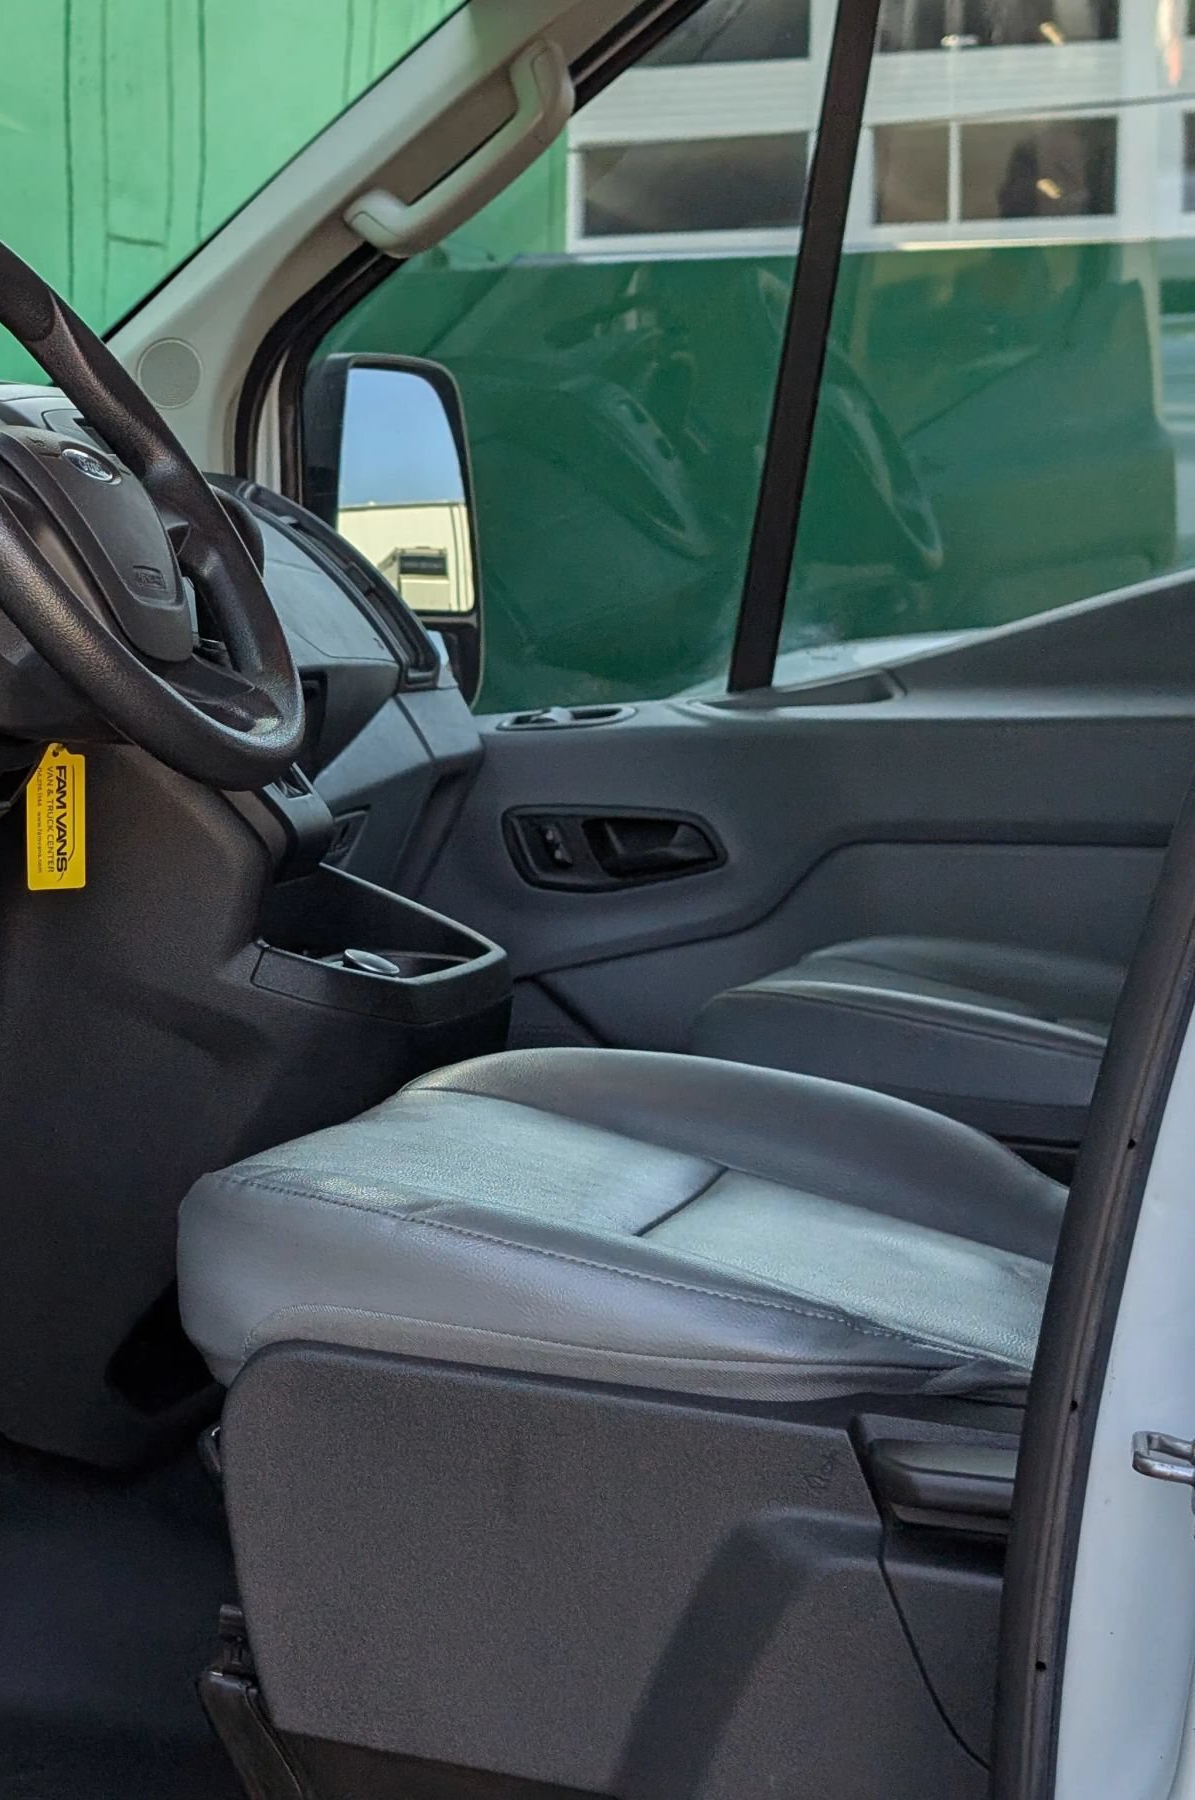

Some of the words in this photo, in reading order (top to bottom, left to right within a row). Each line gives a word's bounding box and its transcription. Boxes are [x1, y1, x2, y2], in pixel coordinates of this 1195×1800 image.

[47, 789, 54, 797] &
[56, 765, 67, 810] FAM
[47, 834, 55, 873] CENTER
[56, 811, 68, 873] VANS
